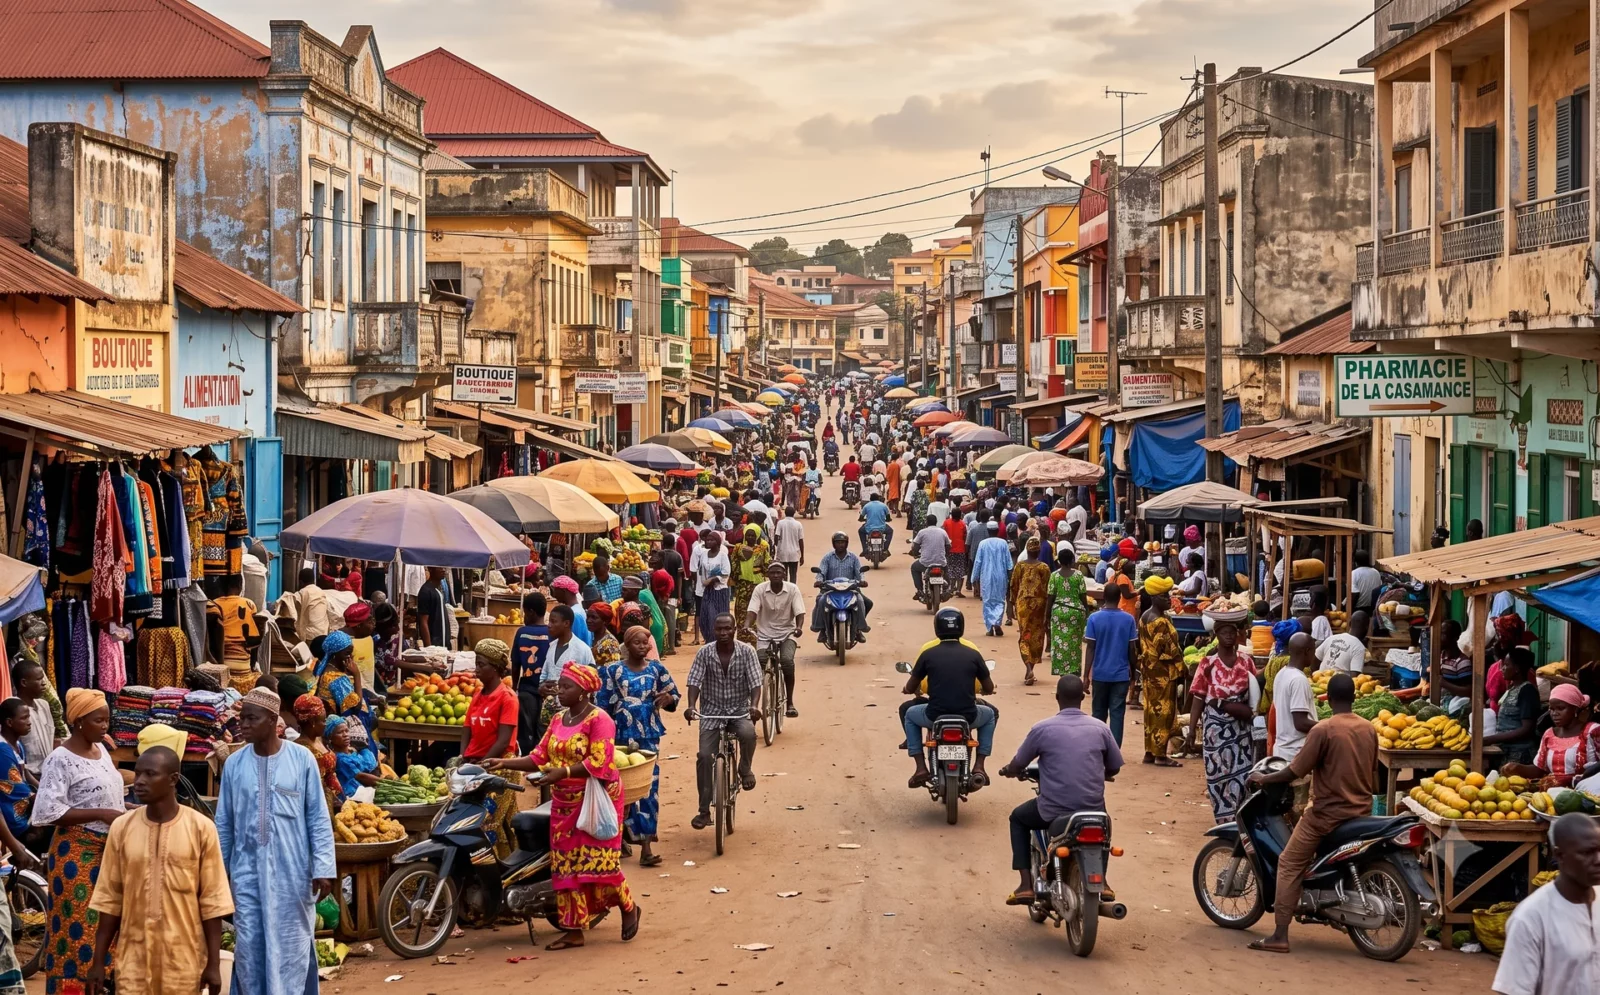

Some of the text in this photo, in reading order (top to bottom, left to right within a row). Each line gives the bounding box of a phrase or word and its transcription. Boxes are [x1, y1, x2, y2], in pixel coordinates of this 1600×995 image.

[92, 337, 152, 372] BOUTIQUE
[456, 367, 514, 380] BOUTIQUE
[1345, 358, 1467, 379] PHARMACIE
[183, 375, 241, 408] ALIMENTATION
[1341, 381, 1471, 400] DE LA CASAMANCE
